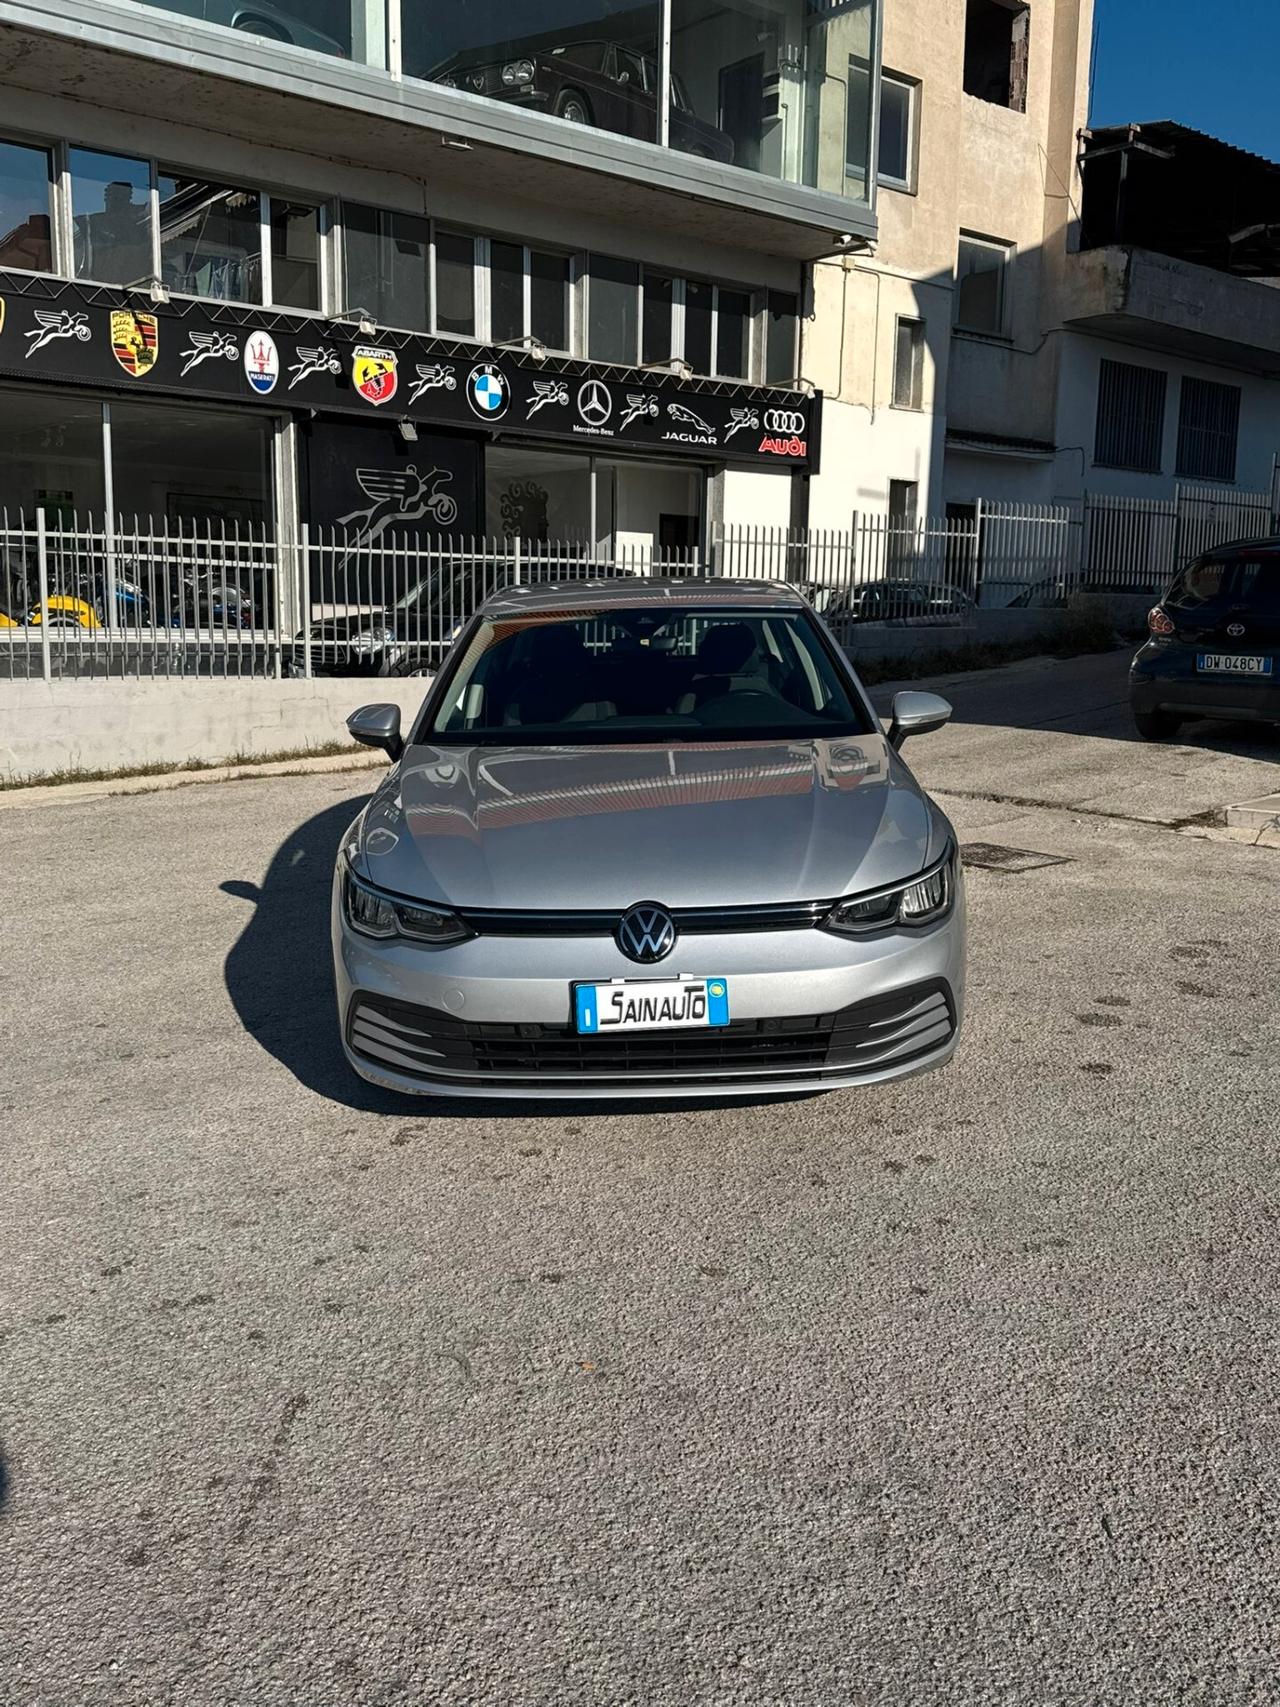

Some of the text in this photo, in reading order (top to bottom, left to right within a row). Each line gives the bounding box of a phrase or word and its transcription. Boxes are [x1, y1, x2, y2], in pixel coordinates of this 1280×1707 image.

[112, 311, 156, 324] PORCHE
[356, 349, 394, 361] ABARTH
[471, 365, 505, 386] BMW
[573, 424, 614, 436] Mercedes-Benz
[661, 431, 718, 445] JAGUAR
[1206, 656, 1220, 669] DW
[600, 985, 706, 1025] SAINAUTO
